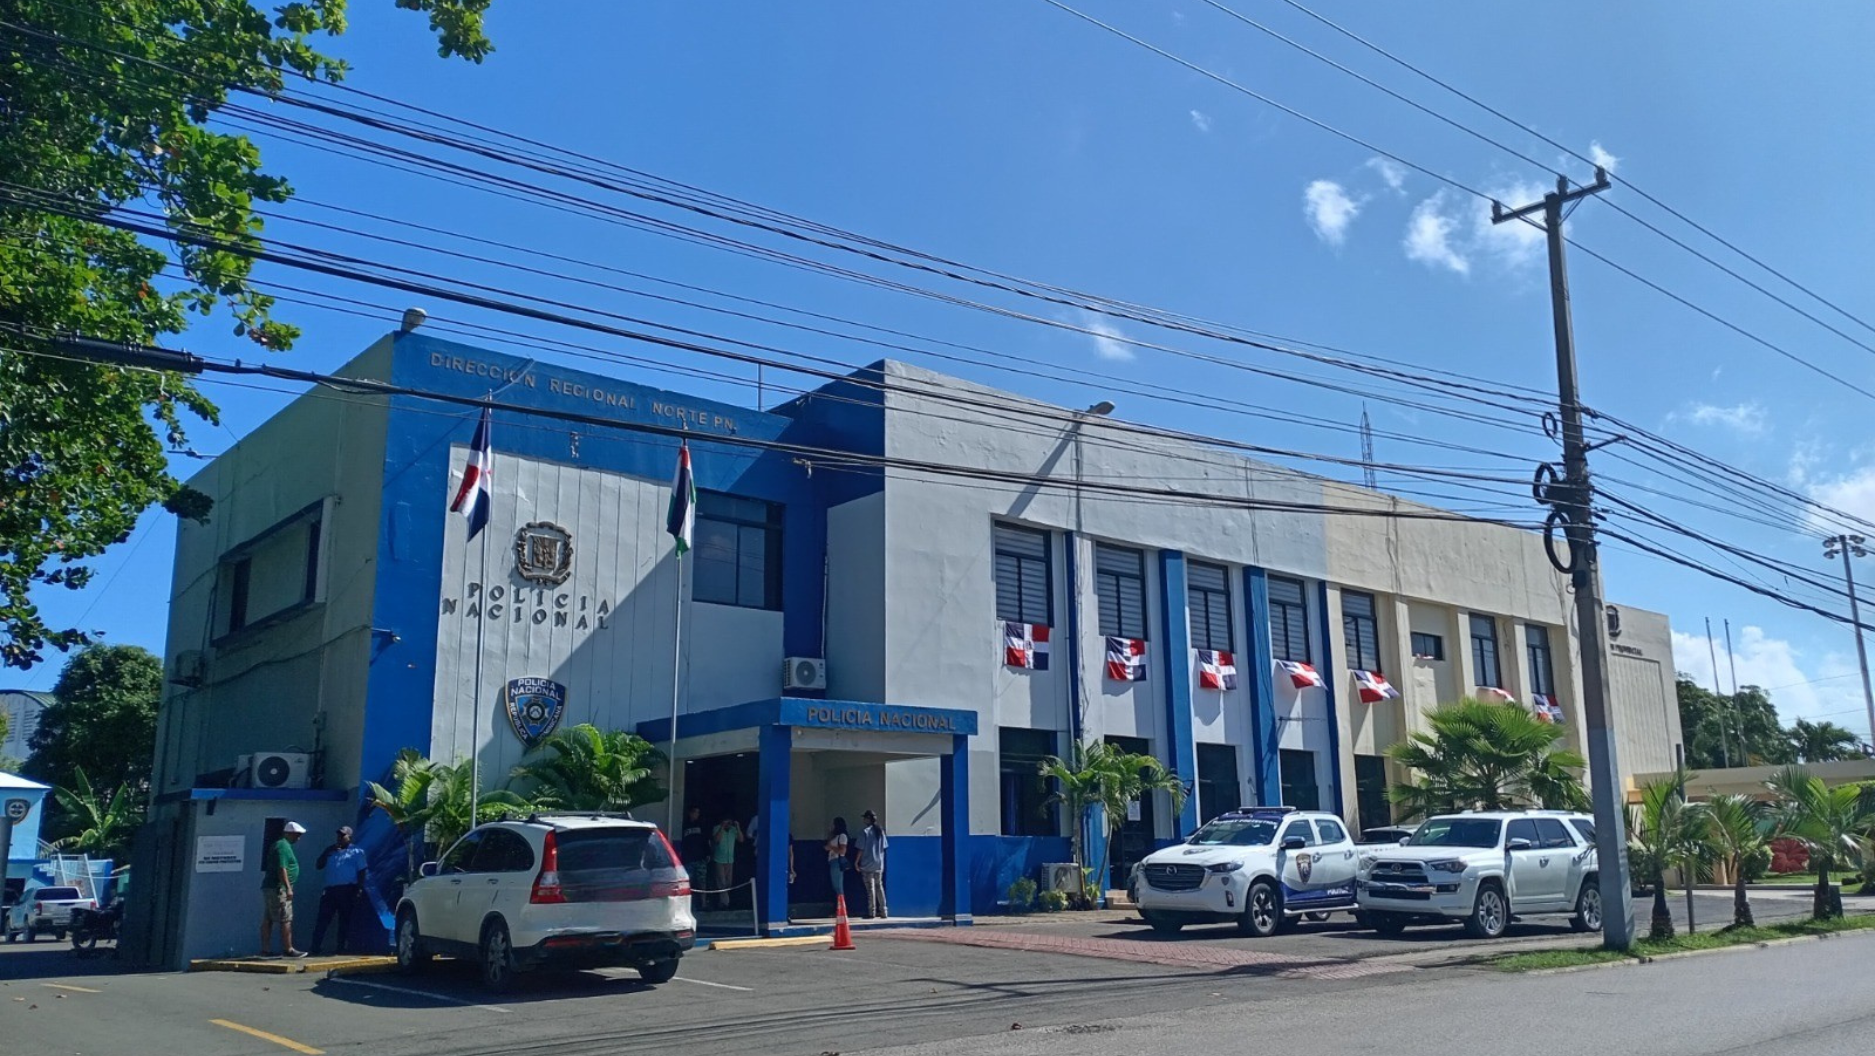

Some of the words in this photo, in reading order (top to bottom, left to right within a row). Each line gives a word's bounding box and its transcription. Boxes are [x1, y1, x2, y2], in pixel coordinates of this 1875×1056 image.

[430, 351, 536, 388] DIRECCION
[549, 378, 636, 411] REGIONAL
[652, 401, 708, 424] NORTE
[467, 582, 609, 615] POLICIA
[441, 598, 609, 630] NACIONAL
[510, 686, 561, 700] NACIONAL
[517, 678, 556, 690] POLICIA
[807, 706, 873, 725] POLICIA
[879, 711, 956, 731] NACIONAL
